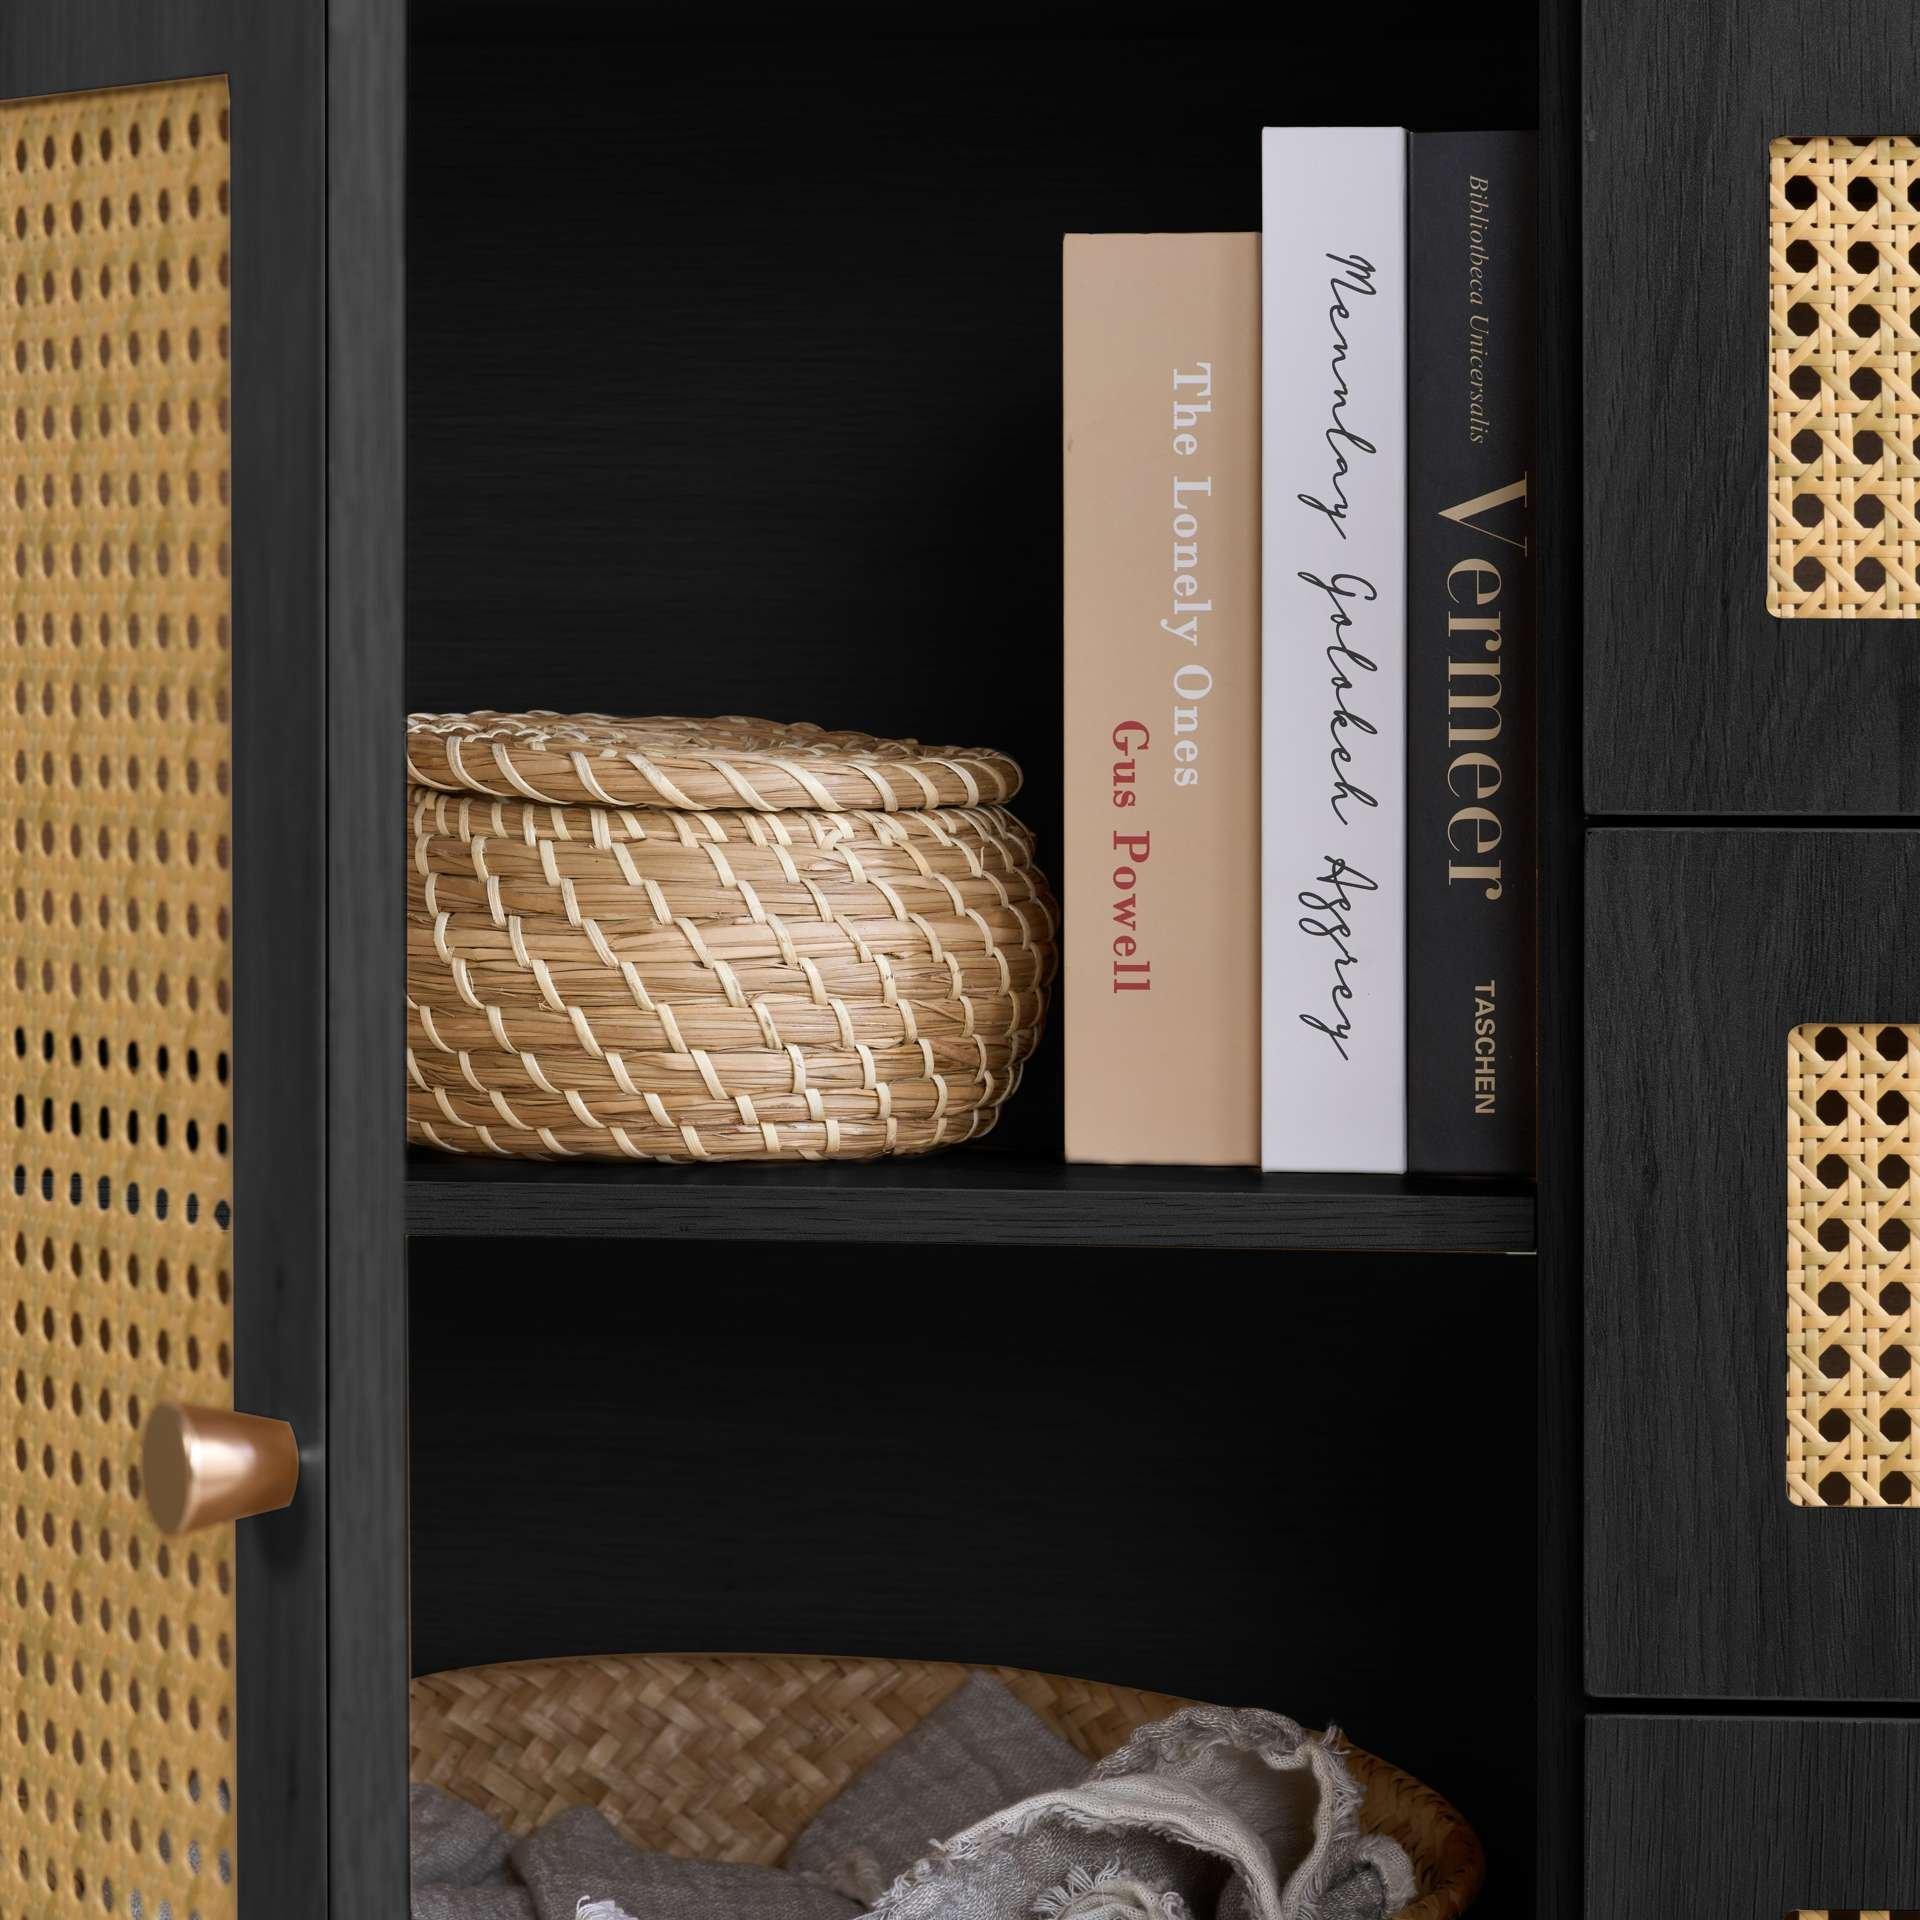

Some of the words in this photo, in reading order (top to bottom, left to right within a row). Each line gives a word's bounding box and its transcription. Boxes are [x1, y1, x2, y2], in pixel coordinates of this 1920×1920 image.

[1172, 361, 1213, 456] The
[1160, 476, 1213, 646] Lonely
[1173, 664, 1213, 787] Ones
[1437, 471, 1528, 902] Vermeer
[1113, 721, 1150, 808] Gus
[1112, 831, 1151, 994] Powell
[1297, 855, 1379, 1063] Aggrey
[1474, 980, 1497, 1115] TASCHEN
